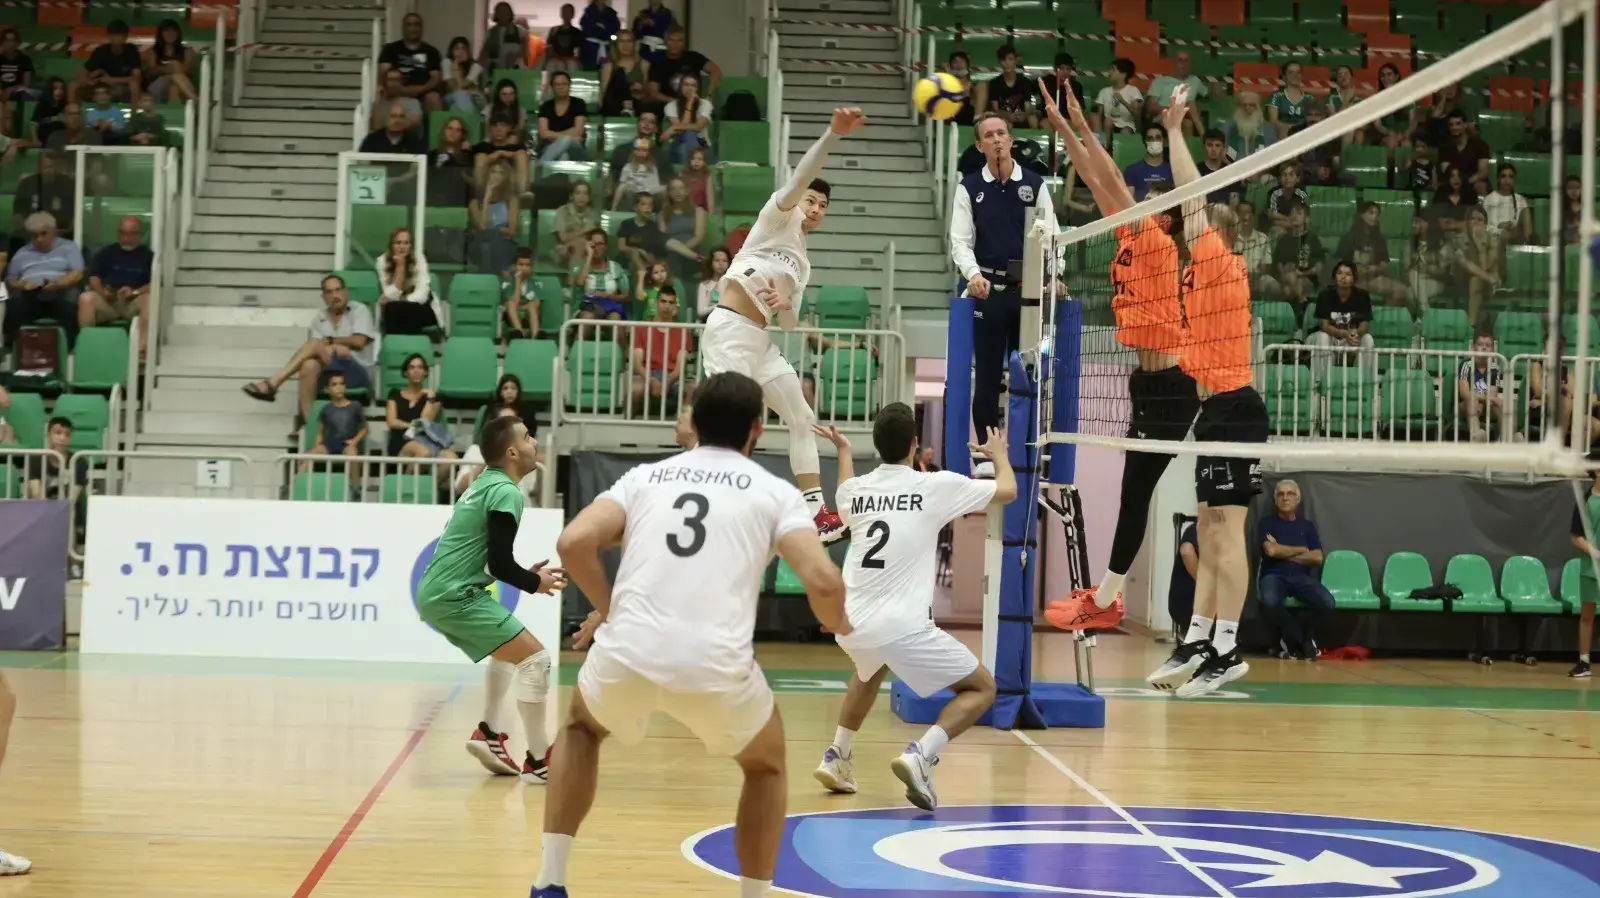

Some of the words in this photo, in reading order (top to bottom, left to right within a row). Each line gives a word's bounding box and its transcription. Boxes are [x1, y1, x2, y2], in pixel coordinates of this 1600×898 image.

[647, 466, 752, 490] HERSHKO
[851, 494, 923, 515] MAINER
[666, 492, 709, 558] 3
[861, 519, 891, 569] 2
[223, 544, 380, 588] קבוצת
[117, 592, 189, 621] עליך.
[276, 599, 378, 621] חושבים
